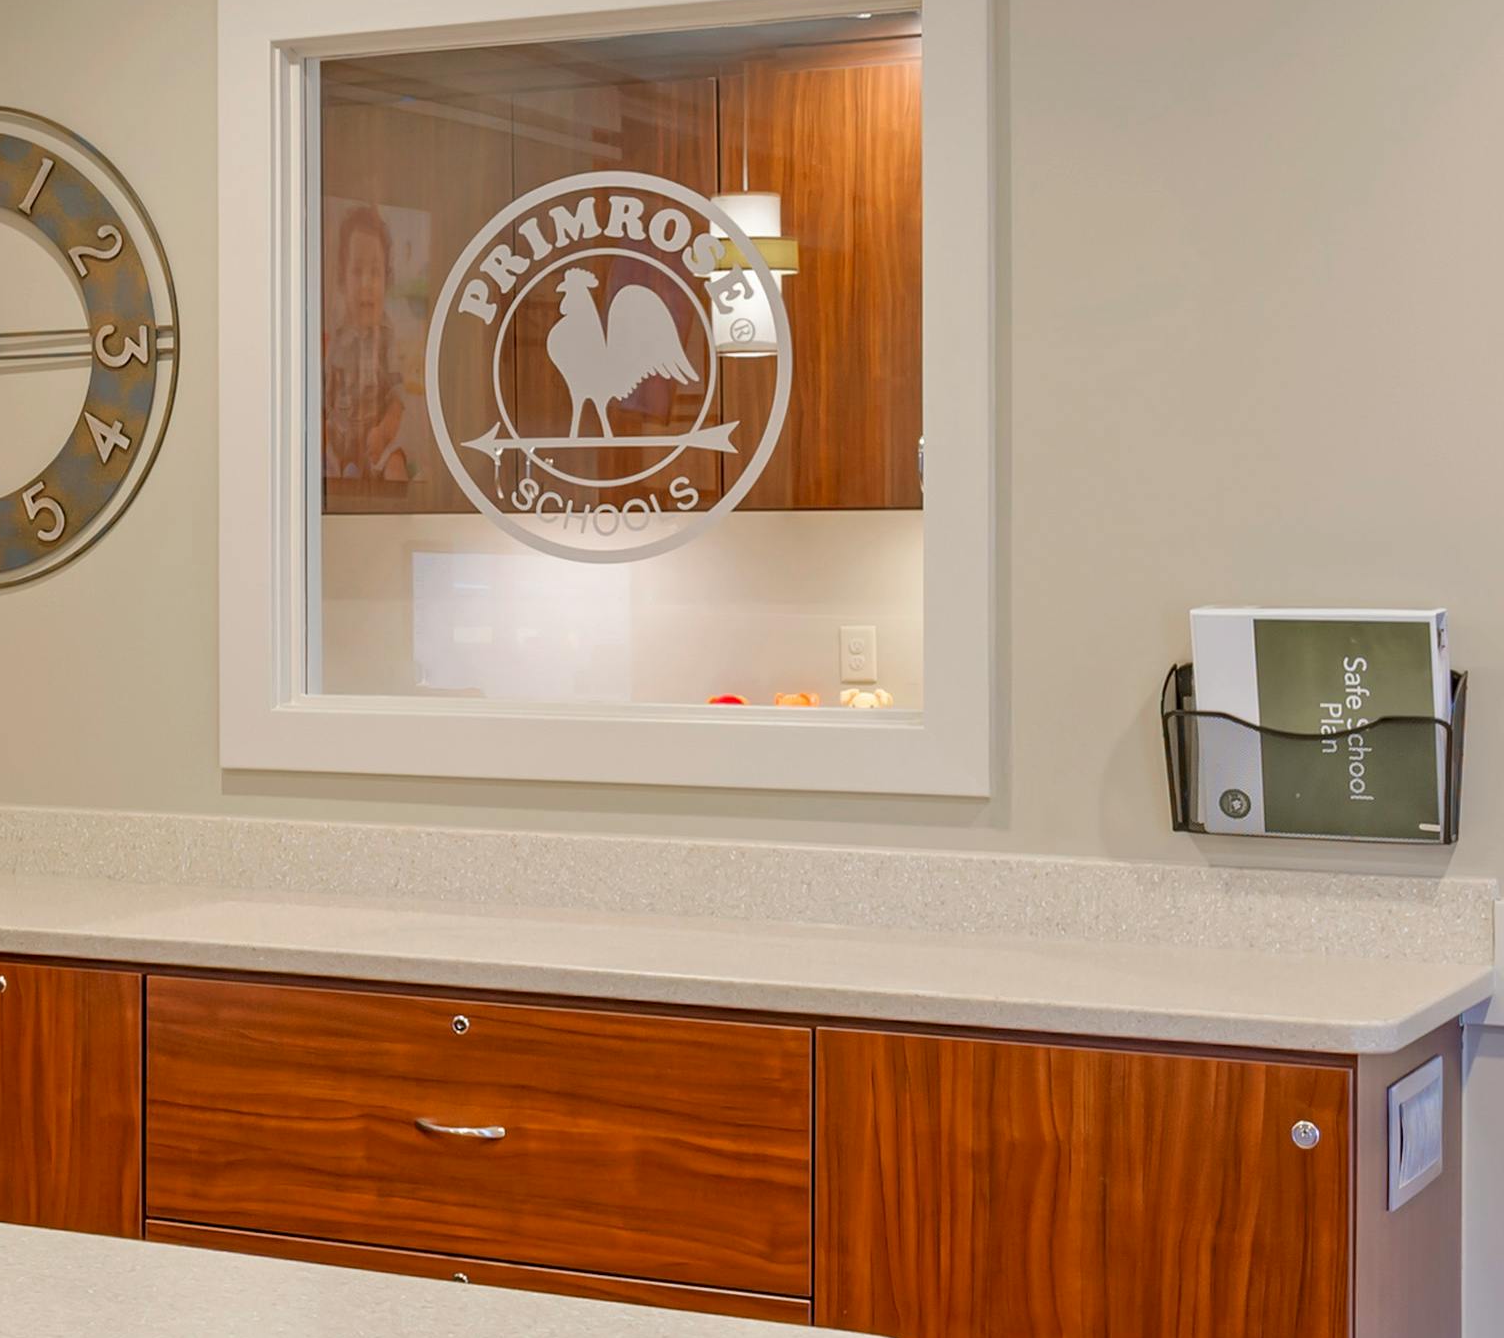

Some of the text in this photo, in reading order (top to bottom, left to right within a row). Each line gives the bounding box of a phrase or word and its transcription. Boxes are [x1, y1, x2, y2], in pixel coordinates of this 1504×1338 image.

[17, 156, 55, 215] 1
[67, 224, 125, 278] 2
[93, 323, 150, 370] 3
[84, 411, 132, 465] 4
[21, 481, 66, 542] 5
[511, 476, 699, 536] SCHOOLS
[1343, 657, 1370, 710] Safe
